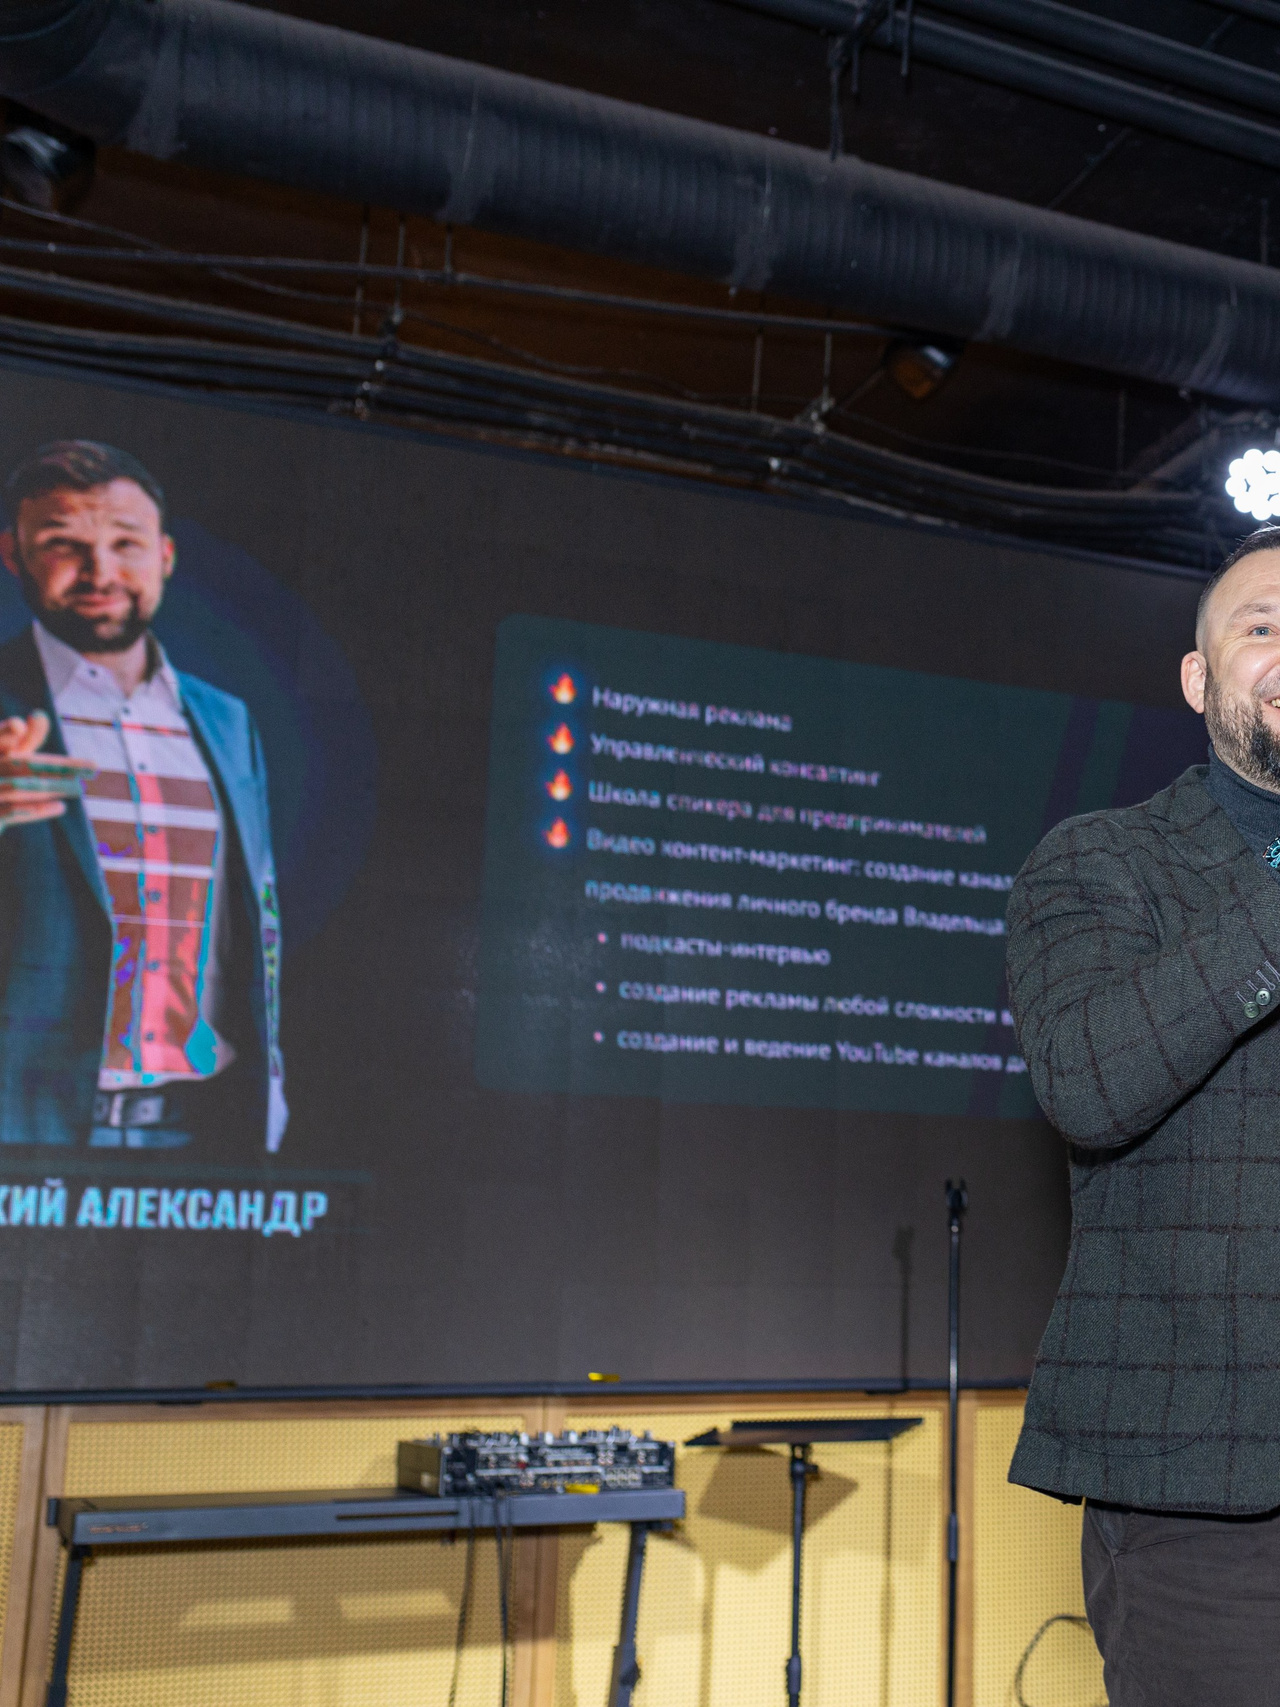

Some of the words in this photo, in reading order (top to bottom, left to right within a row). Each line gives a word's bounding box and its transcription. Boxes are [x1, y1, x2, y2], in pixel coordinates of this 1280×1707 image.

[588, 780, 661, 808] Школа
[586, 827, 656, 856] Видео
[864, 860, 955, 886] создание
[736, 894, 821, 919] личного
[825, 899, 898, 925] бренда
[618, 980, 721, 1006] создание
[725, 988, 819, 1012] рекламы
[616, 1030, 719, 1054] создание
[724, 1038, 739, 1053] и
[744, 1039, 831, 1061] ведение
[835, 1040, 919, 1066] YouTube
[923, 1051, 1003, 1071] каналов
[76, 1187, 329, 1238] АЛЕКСАНДР
